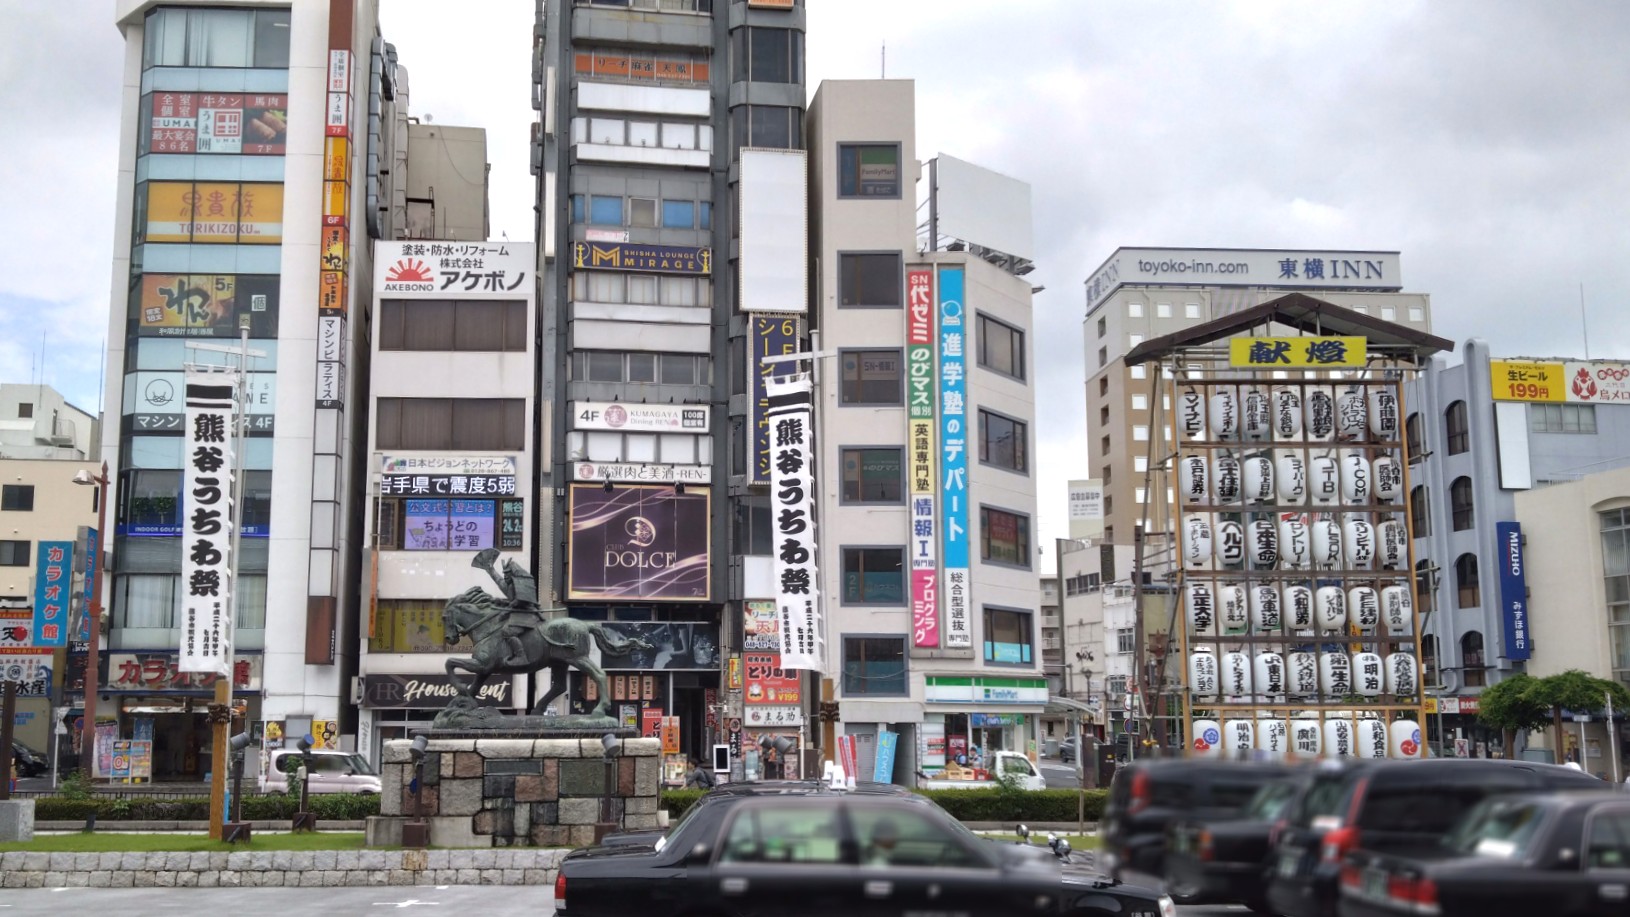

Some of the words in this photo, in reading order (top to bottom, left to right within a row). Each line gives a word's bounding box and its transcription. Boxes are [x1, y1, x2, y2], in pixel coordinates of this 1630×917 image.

[202, 96, 242, 107] 牛タン
[152, 130, 196, 141] 最大宴会
[158, 141, 190, 152] 86名
[257, 145, 273, 153] 7F
[327, 216, 340, 224] 6F
[402, 245, 510, 257] 塗装・防水・リフォーム
[440, 258, 485, 269] 株式会社
[624, 258, 695, 269] MIRAGE
[1138, 258, 1249, 276] toyoko-inn.com
[1278, 258, 1384, 280] 東横INN
[214, 278, 234, 292] 5F
[384, 283, 434, 292] AKEBONO
[440, 270, 526, 292] アケボノ
[911, 348, 930, 406] のびマス
[1507, 370, 1548, 382] 生ビール
[1508, 383, 1549, 398] 199円
[579, 410, 600, 422] 4F
[630, 410, 679, 419] KUMAGAYA
[1185, 393, 1202, 431] マイナビ
[1378, 394, 1396, 432] 伊藤園
[255, 417, 273, 429] 4F
[630, 418, 654, 427] Dining
[942, 333, 964, 542] 進学塾のデパート
[408, 458, 512, 468] 日本ビジョンネットワーク
[915, 423, 930, 492] 英語専門塾
[1322, 457, 1335, 494] JTB
[190, 413, 226, 598] 熊谷うちわ祭
[502, 502, 524, 514] 熊谷
[775, 418, 811, 595] 熊谷うちわ祭
[454, 535, 480, 548] 学習
[1327, 522, 1340, 561] ALSOK
[605, 551, 676, 569] DOLCE
[1509, 531, 1521, 576] MIZUHO
[41, 546, 64, 640] カラオケ館
[950, 572, 964, 631] 総合型選抜
[1192, 586, 1212, 629] 立正大学
[1259, 587, 1279, 627] 馬車道
[1264, 655, 1282, 694] JR東日本
[1329, 653, 1349, 694] 第一生命
[475, 681, 510, 701] ent
